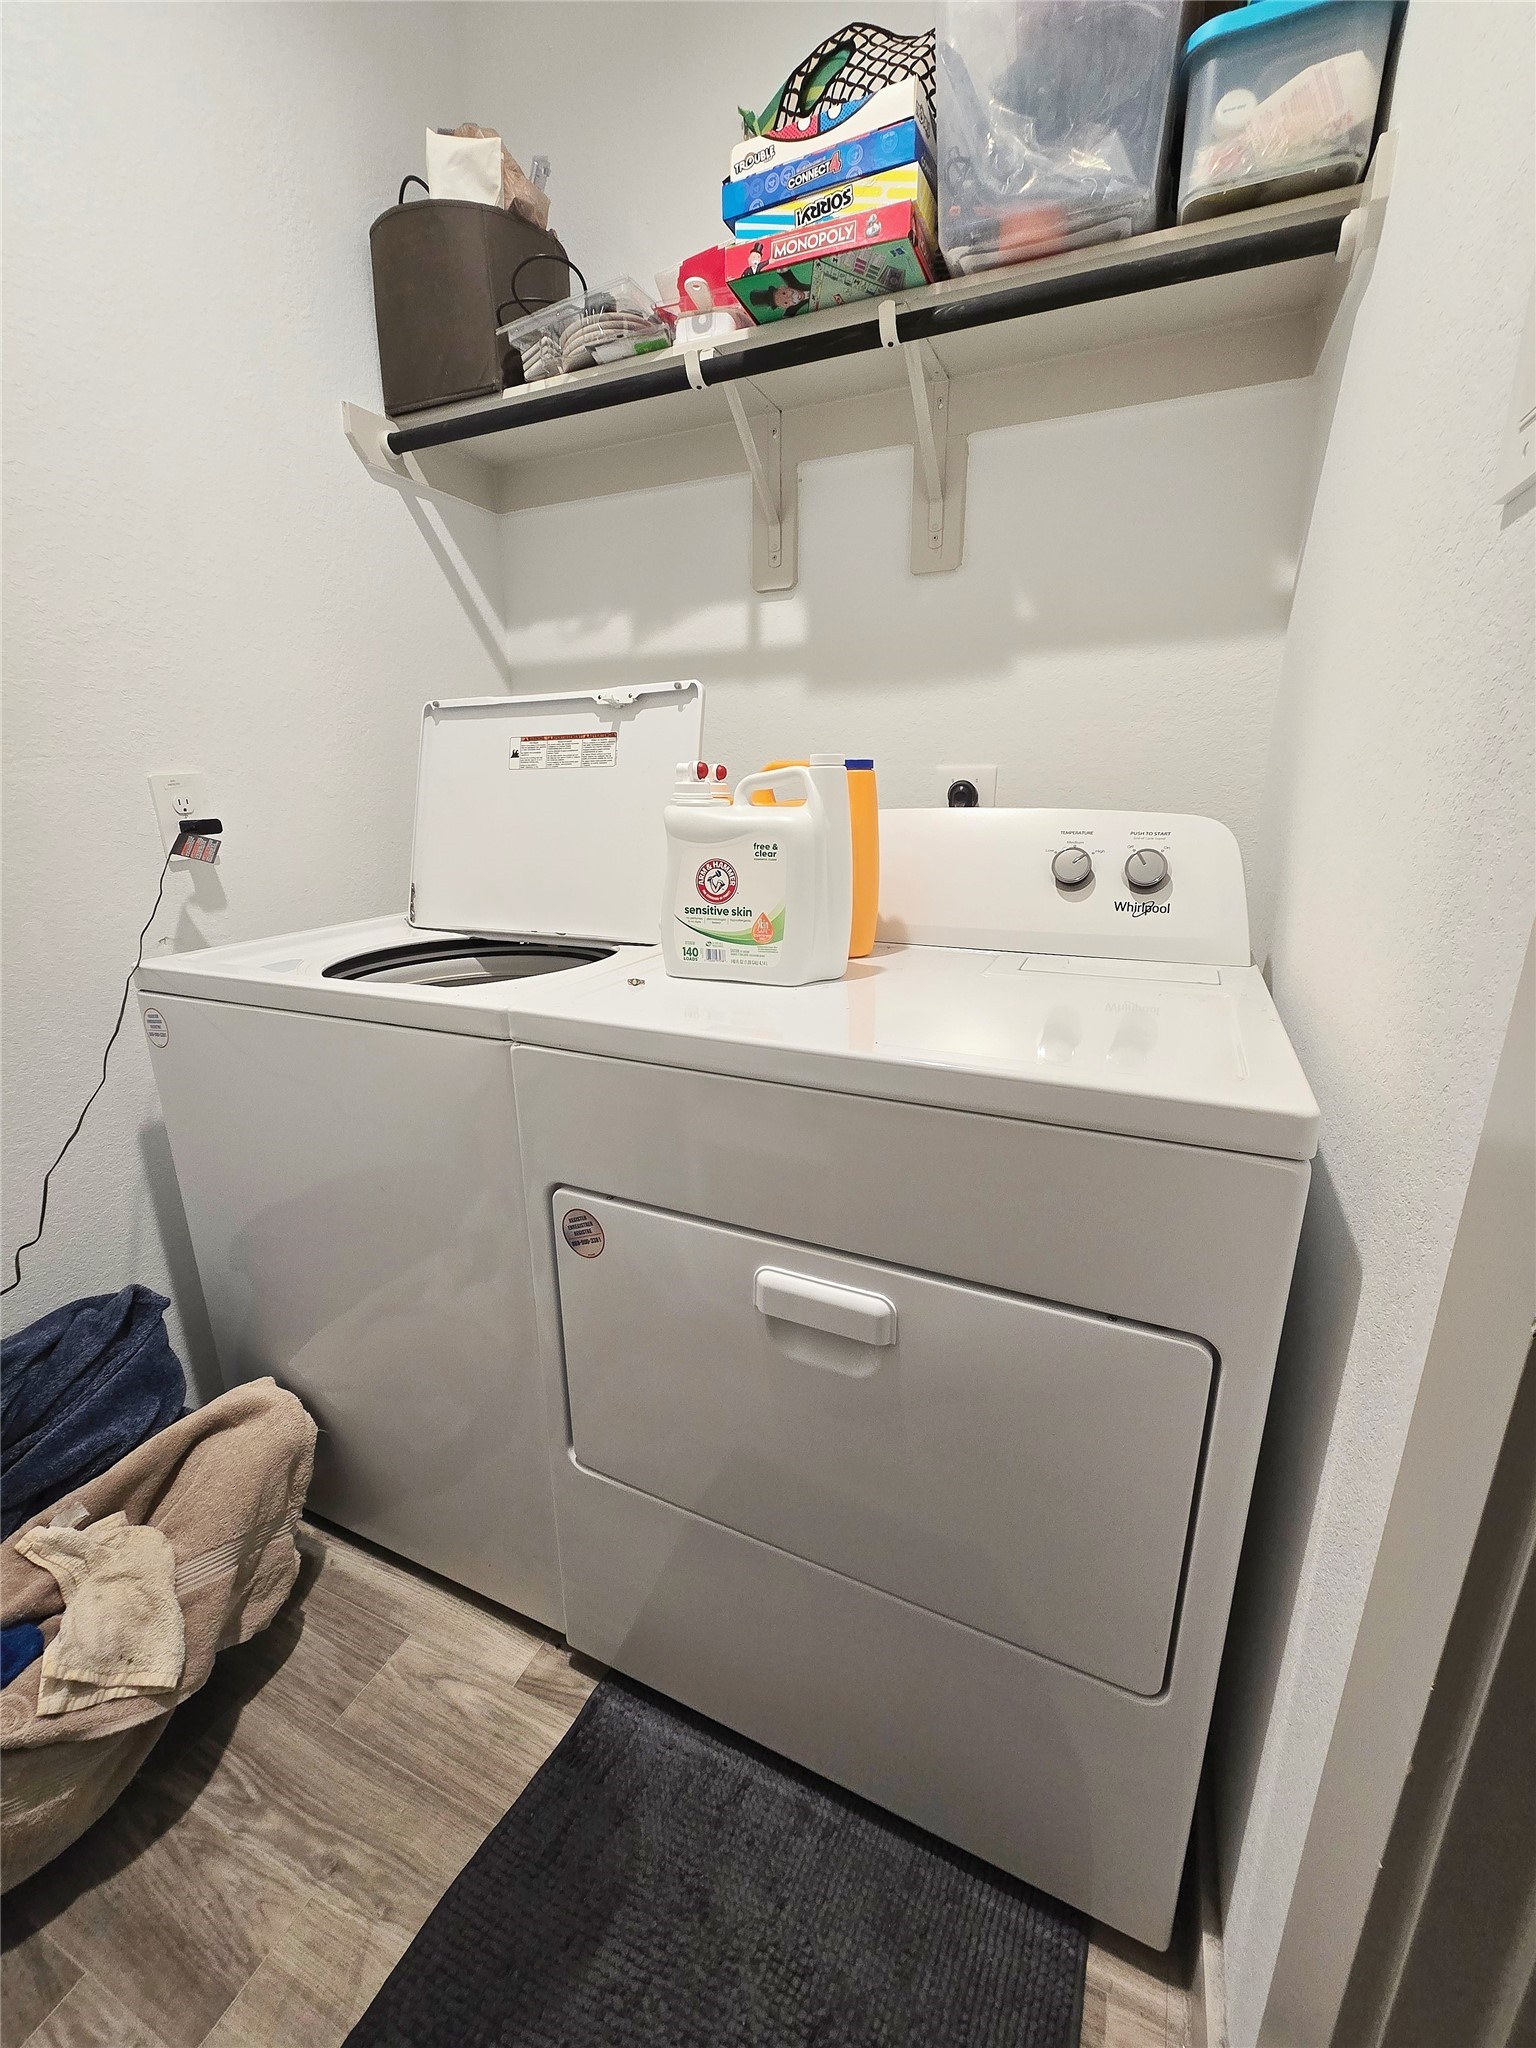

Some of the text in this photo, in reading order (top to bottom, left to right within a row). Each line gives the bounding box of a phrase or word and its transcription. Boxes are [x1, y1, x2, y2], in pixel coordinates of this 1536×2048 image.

[734, 145, 776, 174] TROUBLE
[787, 150, 843, 190] CONNECT 4
[795, 187, 852, 227] SORRY!
[774, 224, 854, 259] MONOPOLY
[753, 842, 771, 850] free
[755, 850, 777, 858] clear
[699, 867, 707, 885] ARM
[713, 861, 736, 886] HAMMER
[684, 905, 752, 917] sensitive skin
[1114, 901, 1171, 917] Whirlpool
[682, 947, 699, 957] 140
